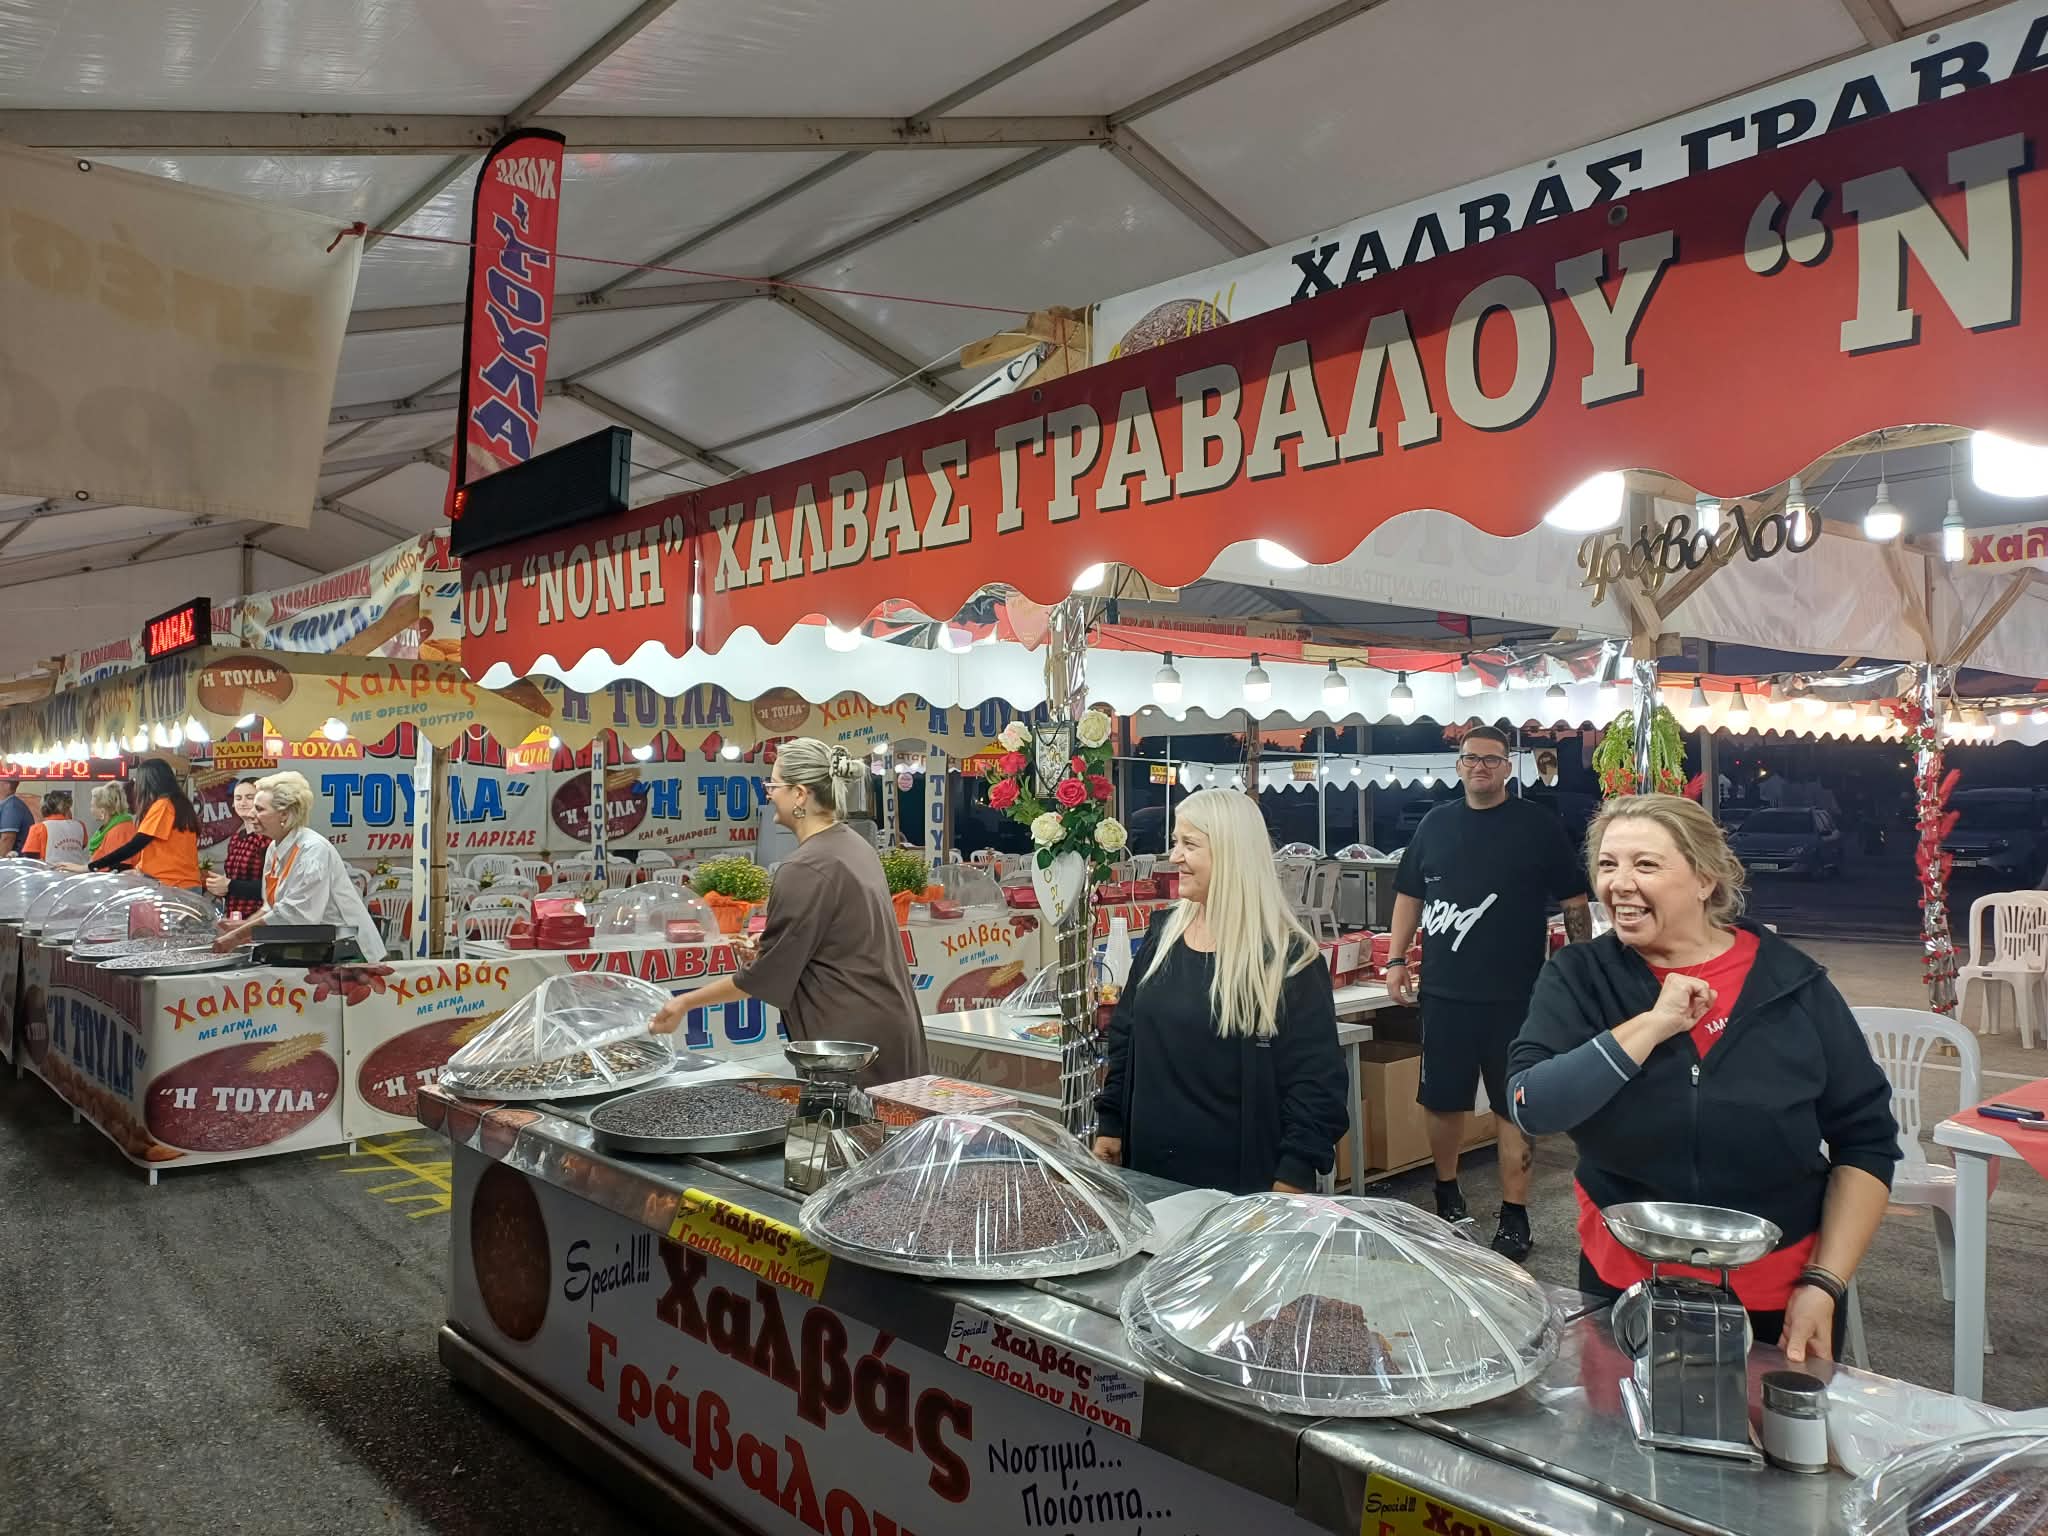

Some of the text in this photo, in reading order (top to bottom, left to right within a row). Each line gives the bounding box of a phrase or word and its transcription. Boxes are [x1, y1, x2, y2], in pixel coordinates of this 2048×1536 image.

[708, 132, 2031, 594] ΧΑΛΒΑΣ ΓΡΑΒΑΛΟΥ “Ν
[462, 514, 685, 639] ΟΥ “ΝΟΝΗ”
[150, 607, 196, 657] ΧΑΛΒΑΣ
[351, 702, 428, 722] ΜΕ ΦΡΕΣΚΟ
[419, 710, 475, 727] ΒΟΥΤΥΡΟ
[231, 758, 276, 769] ΤΟΥΛΑ
[290, 741, 359, 758] ΤΟΥΛΑ
[631, 777, 683, 820] "Η
[465, 828, 537, 848] ΛΑΡΙΣΑΣ
[592, 783, 606, 881] ΤΟΥΛΑ
[638, 831, 654, 841] ΚΑΙ
[416, 994, 465, 1017] ΜΕ ΑΓΝΑ
[454, 998, 486, 1017] ΥΛΙΚΑ
[197, 1018, 254, 1041] ΜΕ ΑΓΝΑ
[243, 1023, 279, 1041] ΥΛΙΚΑ
[159, 1086, 329, 1114] "Η ΤΟΥΛΑ"
[372, 1074, 408, 1099] "Η
[711, 1202, 792, 1257] Χαλβάς
[563, 1232, 651, 1312] Special!!!
[677, 1222, 763, 1273] Γράβαλου
[765, 1259, 816, 1297] Νόνη
[656, 1236, 974, 1505] Χαλβάς
[991, 1323, 1093, 1390] Χαλβάς
[955, 1343, 1132, 1436] Γράβαλου Νόνη
[586, 1320, 922, 1535] Γράβαλο
[988, 1425, 1122, 1491] Νοστιμιά...
[1021, 1479, 1172, 1528] Ποιότητα...
[1364, 1492, 1417, 1521] Special!!!
